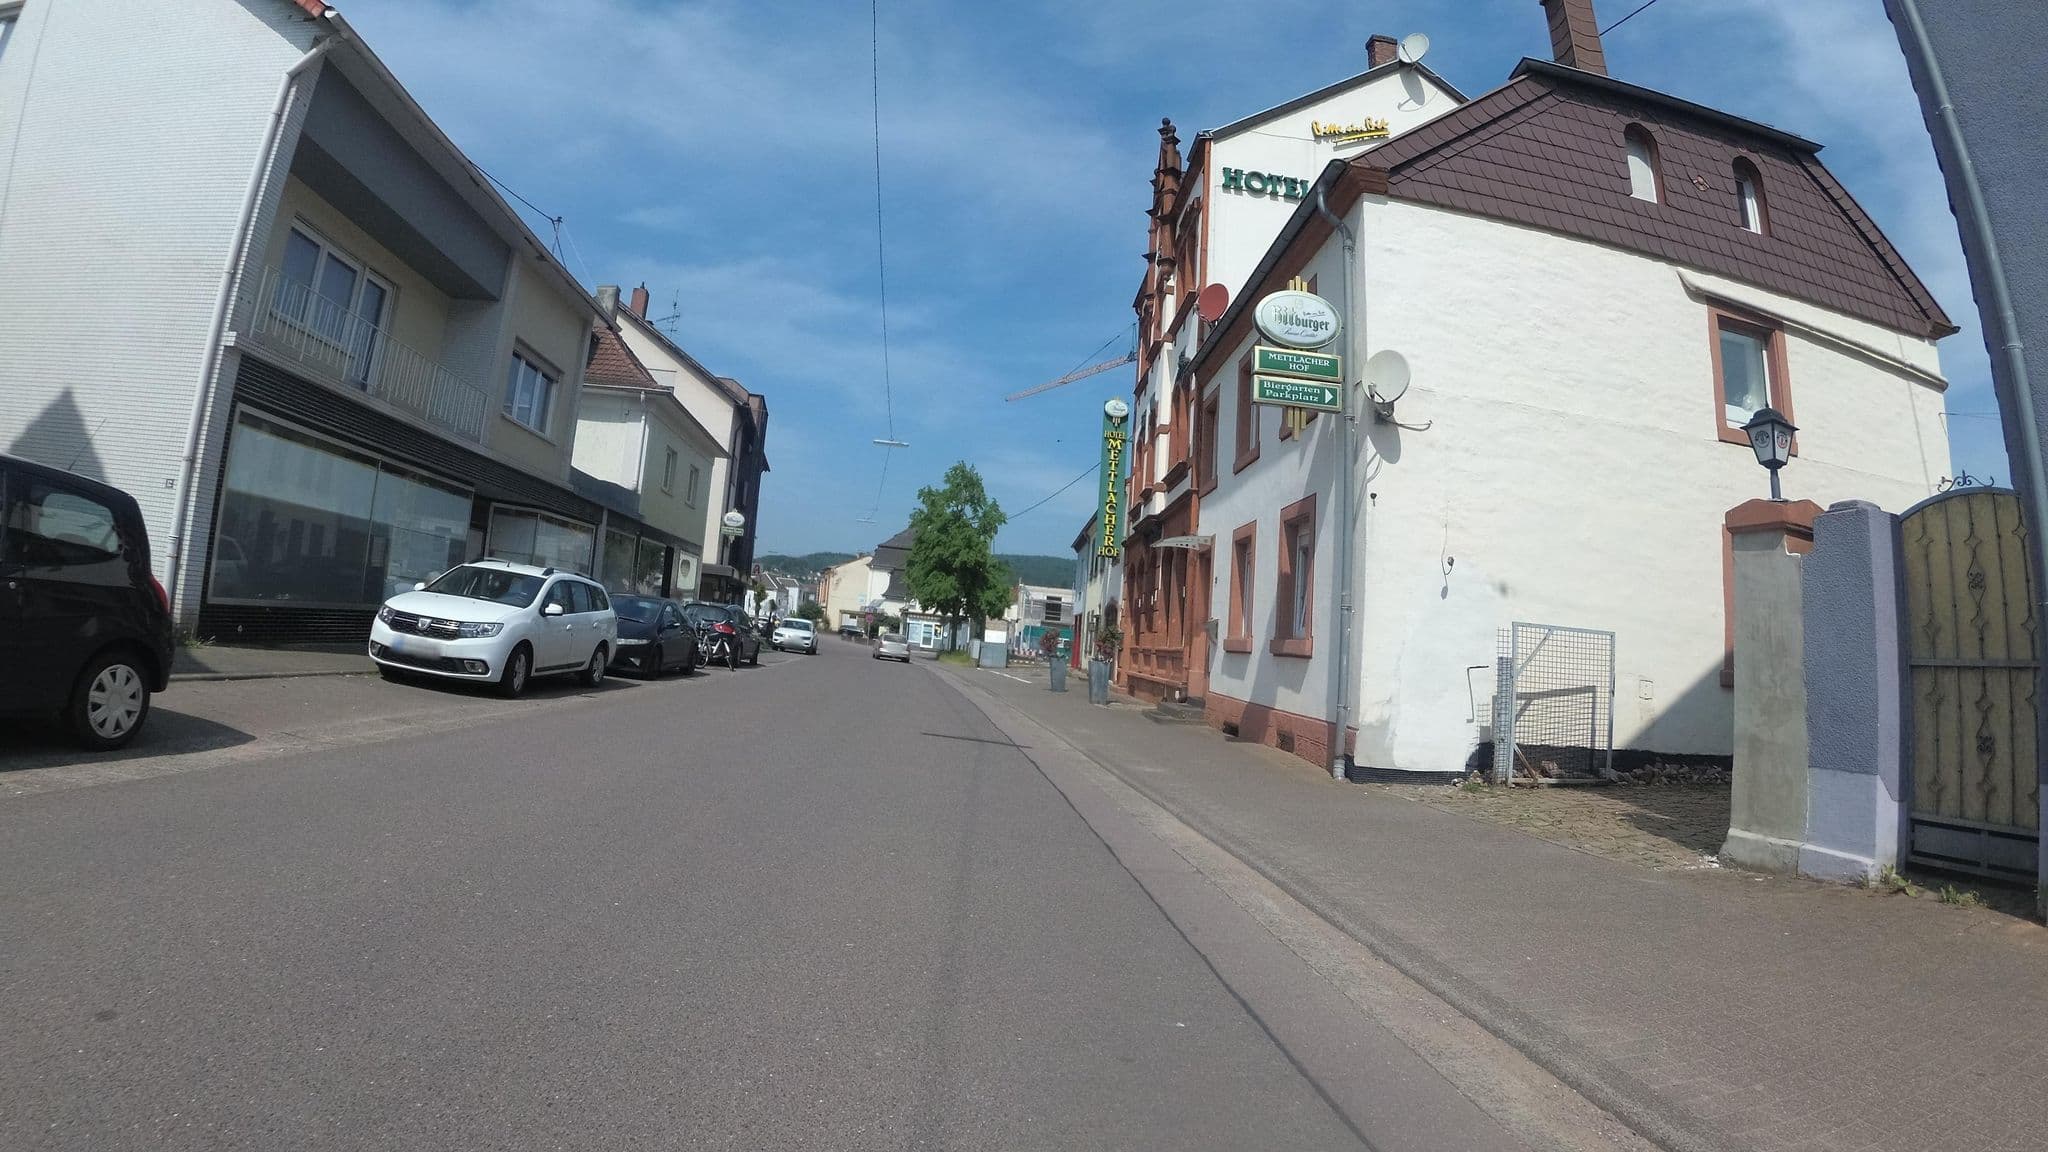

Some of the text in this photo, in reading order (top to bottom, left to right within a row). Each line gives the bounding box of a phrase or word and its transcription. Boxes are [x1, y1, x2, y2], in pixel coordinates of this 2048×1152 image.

[1268, 353, 1330, 367] METTLACHER
[1289, 363, 1310, 372] HOF
[1263, 381, 1320, 393] Biergarten
[1265, 389, 1319, 402] Parkplatz
[1104, 430, 1126, 439] HOTEL
[1104, 438, 1121, 546] METTLACHER
[1098, 546, 1120, 557] HOF
